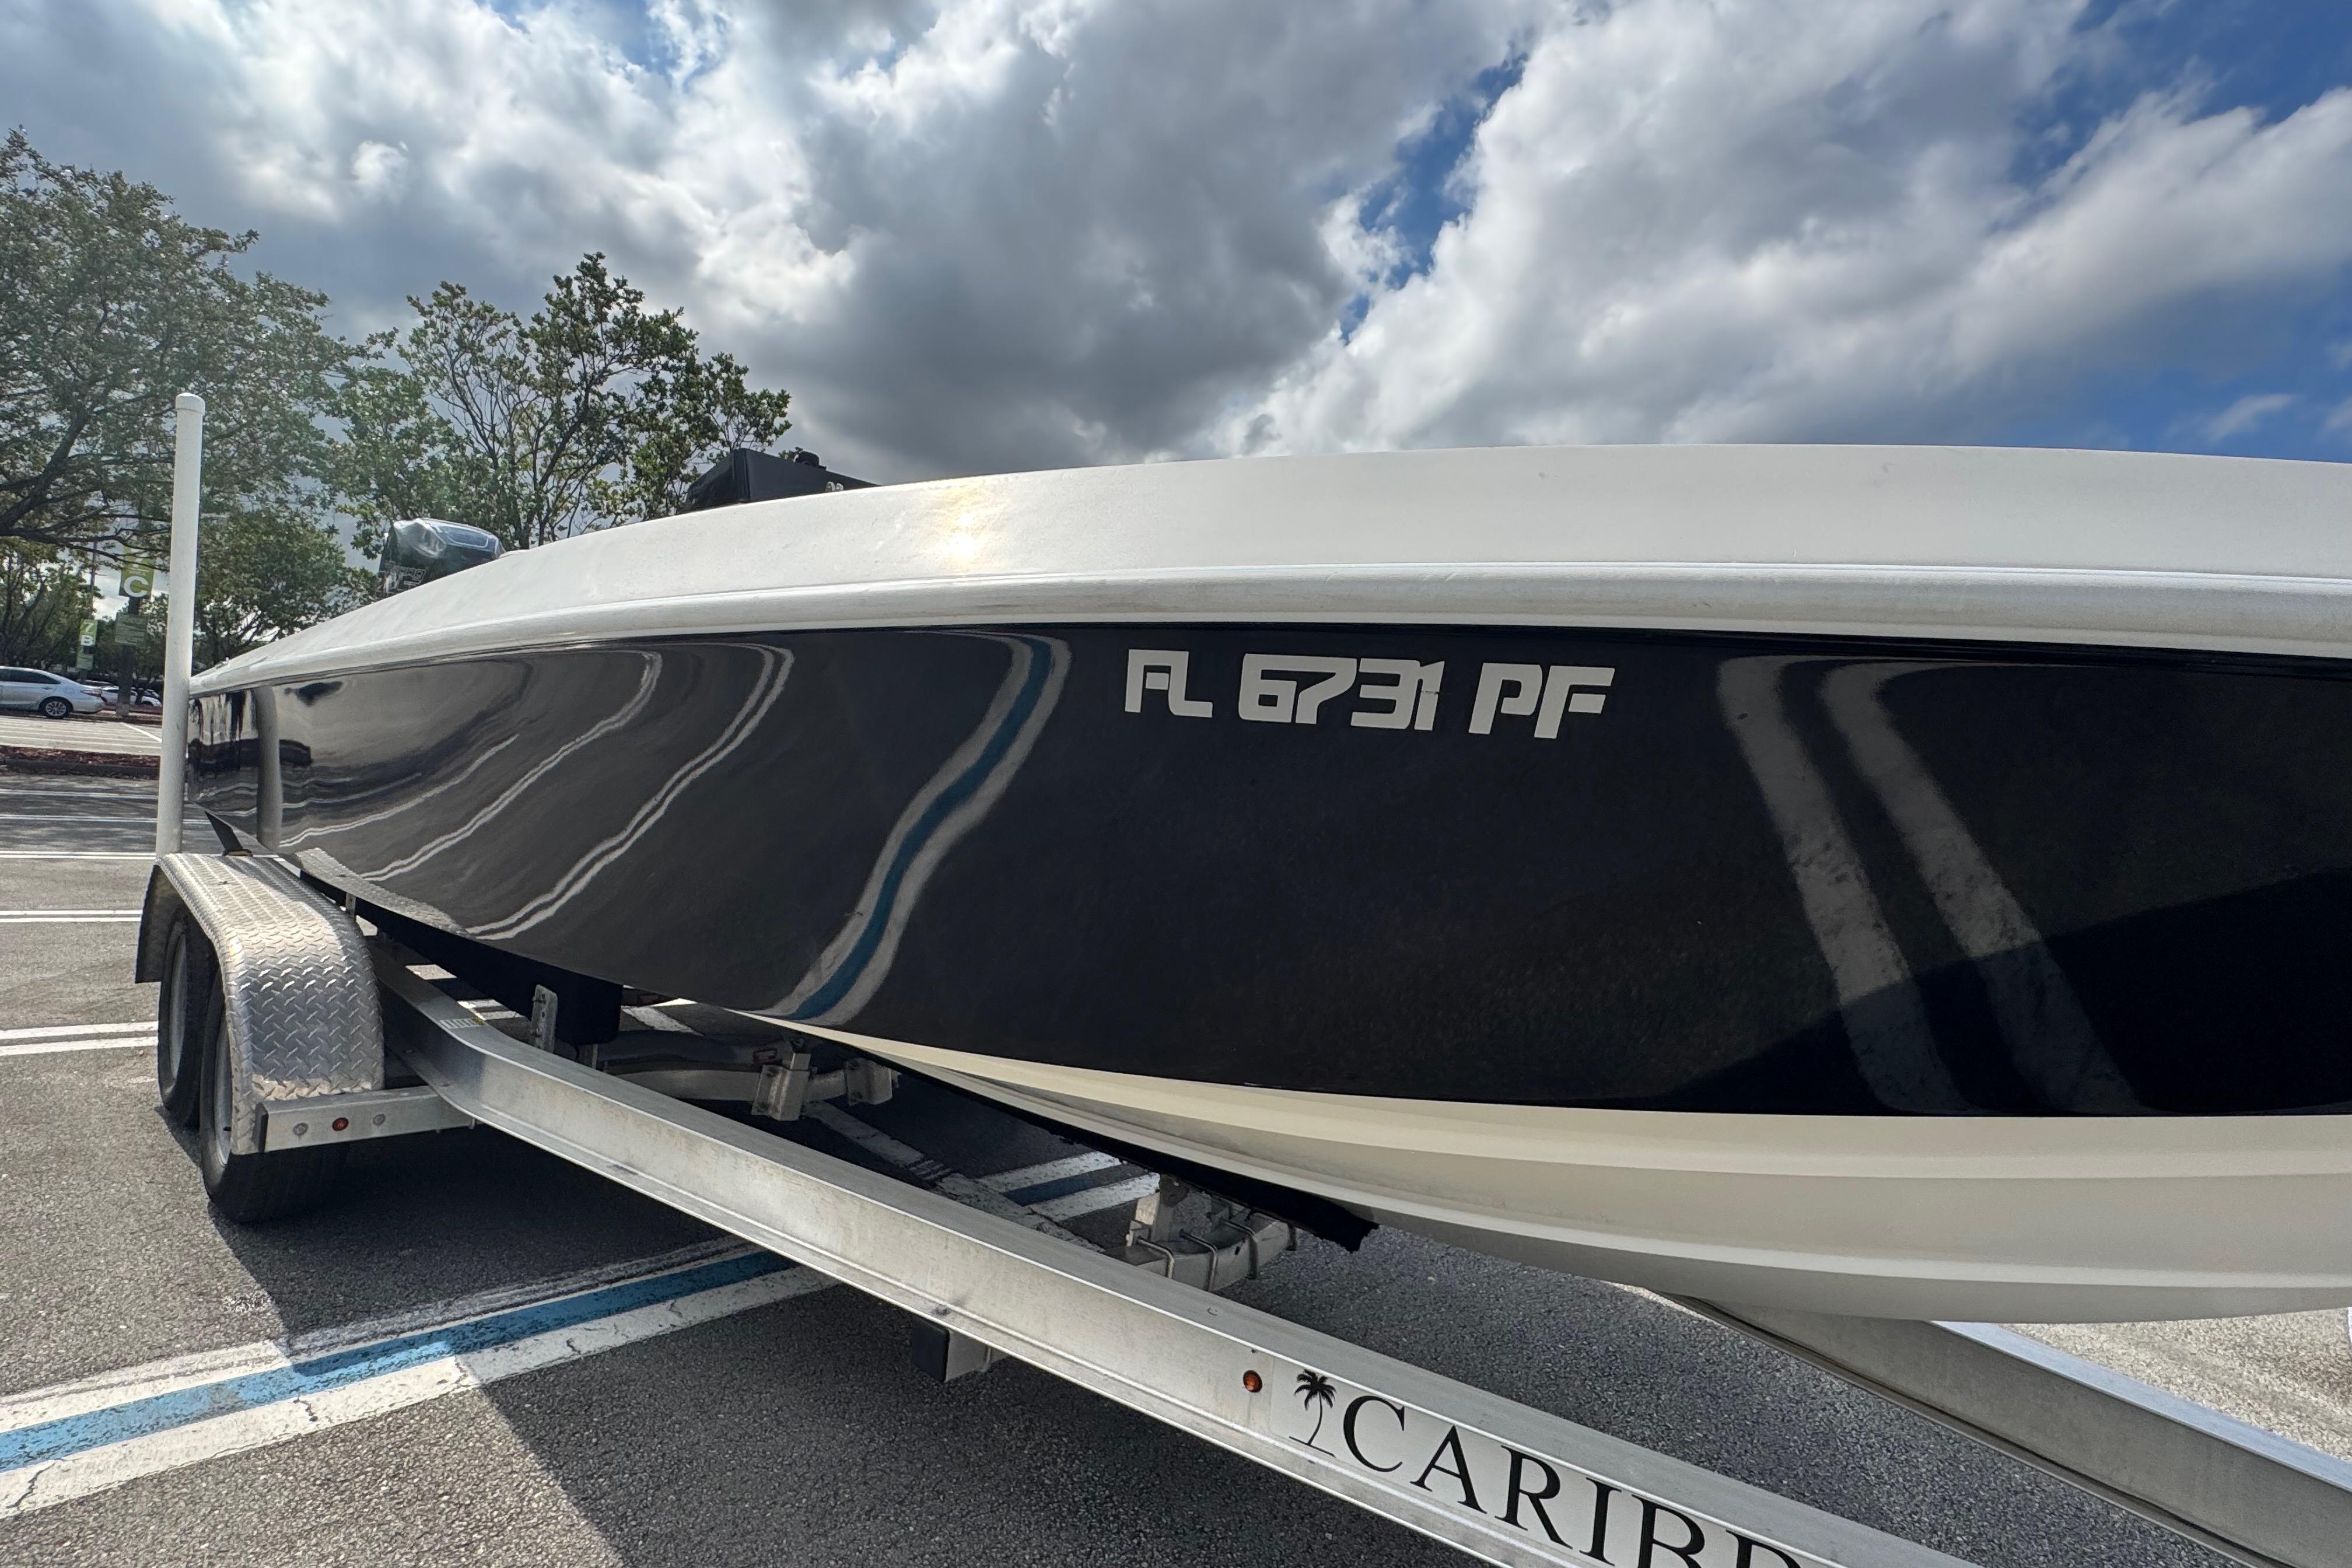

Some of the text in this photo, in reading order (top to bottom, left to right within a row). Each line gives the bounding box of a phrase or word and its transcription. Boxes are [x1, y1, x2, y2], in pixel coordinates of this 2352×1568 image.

[124, 575, 149, 597] C
[84, 622, 94, 632] 7
[80, 635, 94, 646] B
[1125, 649, 1616, 739] FL 6731 PF
